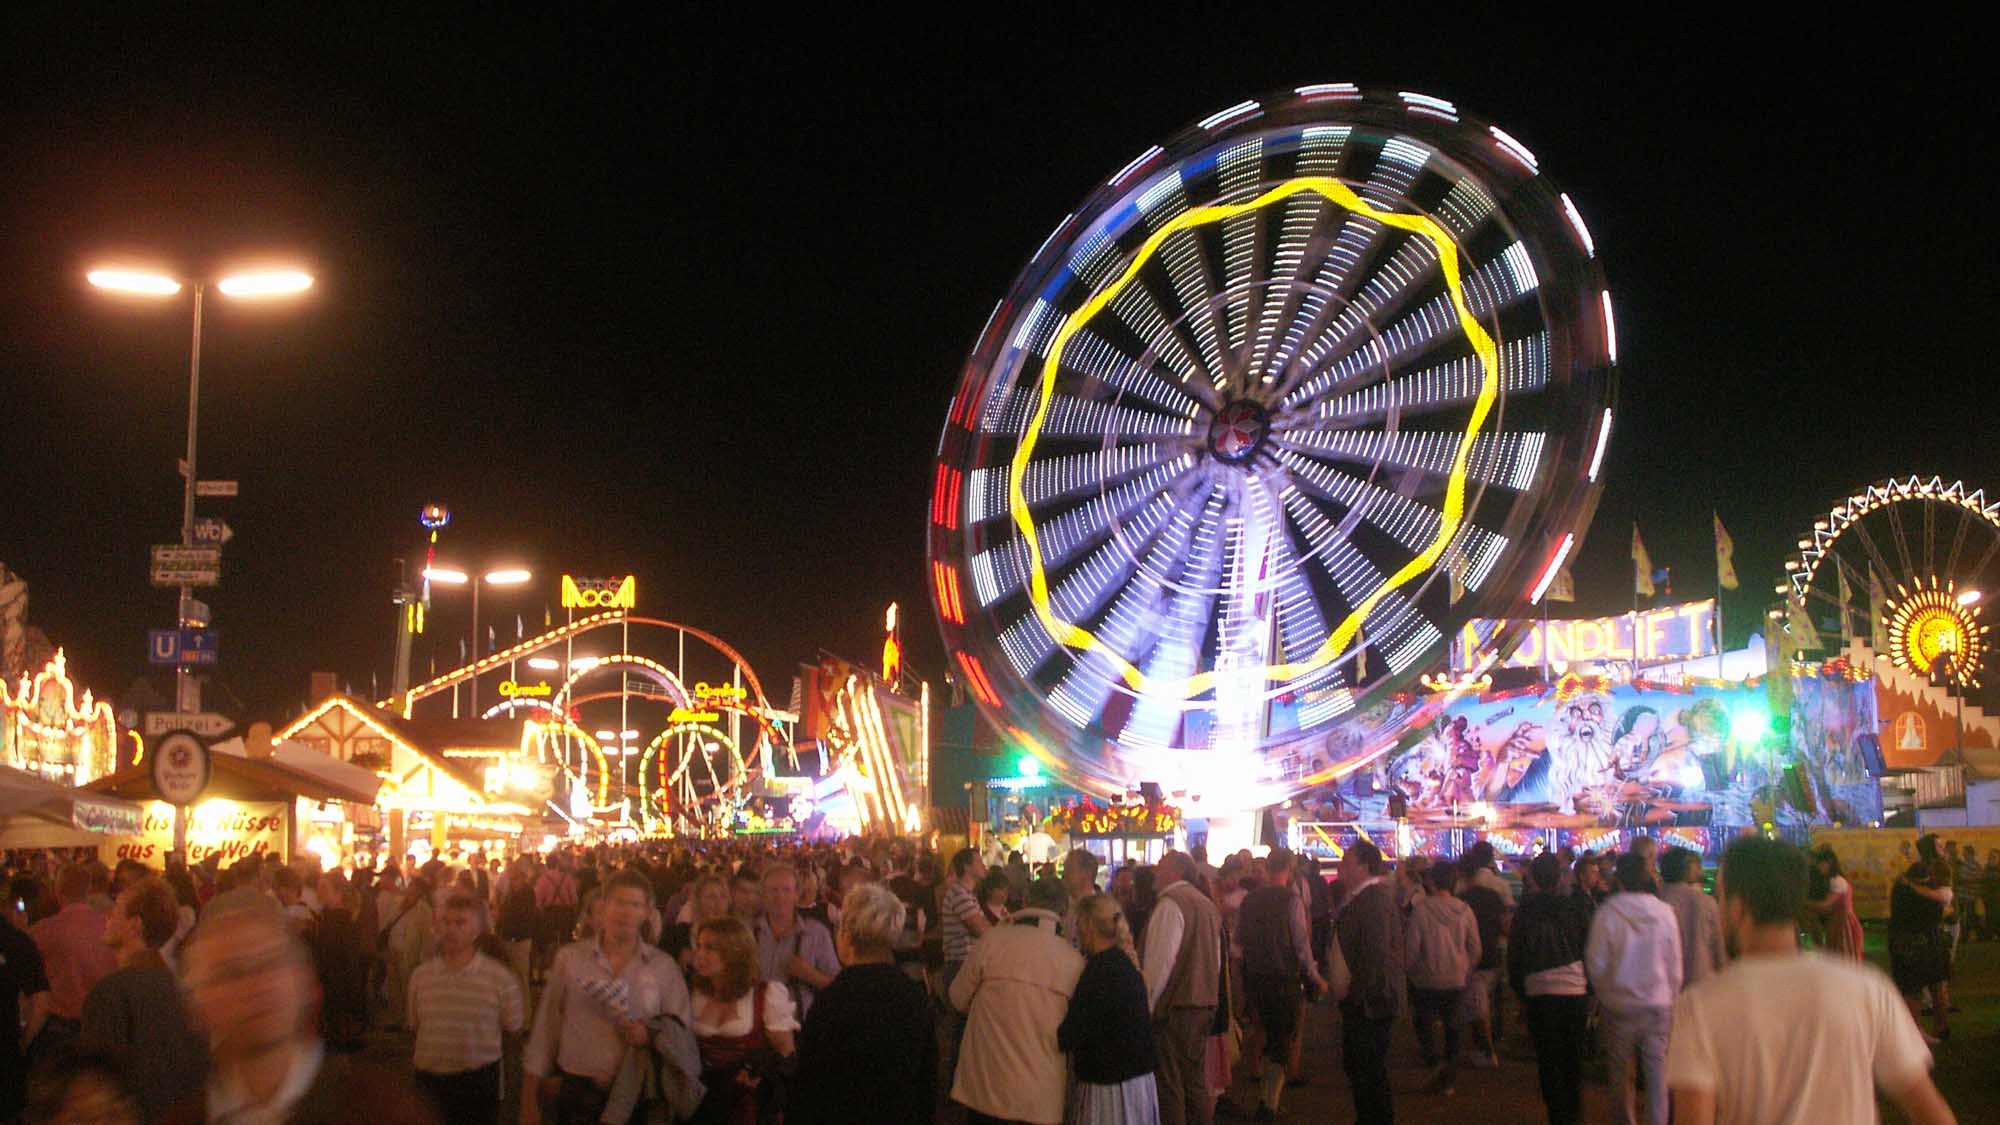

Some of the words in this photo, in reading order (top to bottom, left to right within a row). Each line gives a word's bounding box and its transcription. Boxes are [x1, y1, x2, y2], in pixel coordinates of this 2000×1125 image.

[1462, 598, 1717, 671] MONDLIFT
[156, 634, 174, 656] U
[155, 716, 209, 731] Polizei
[117, 844, 155, 859] aus
[222, 840, 269, 859] Welt
